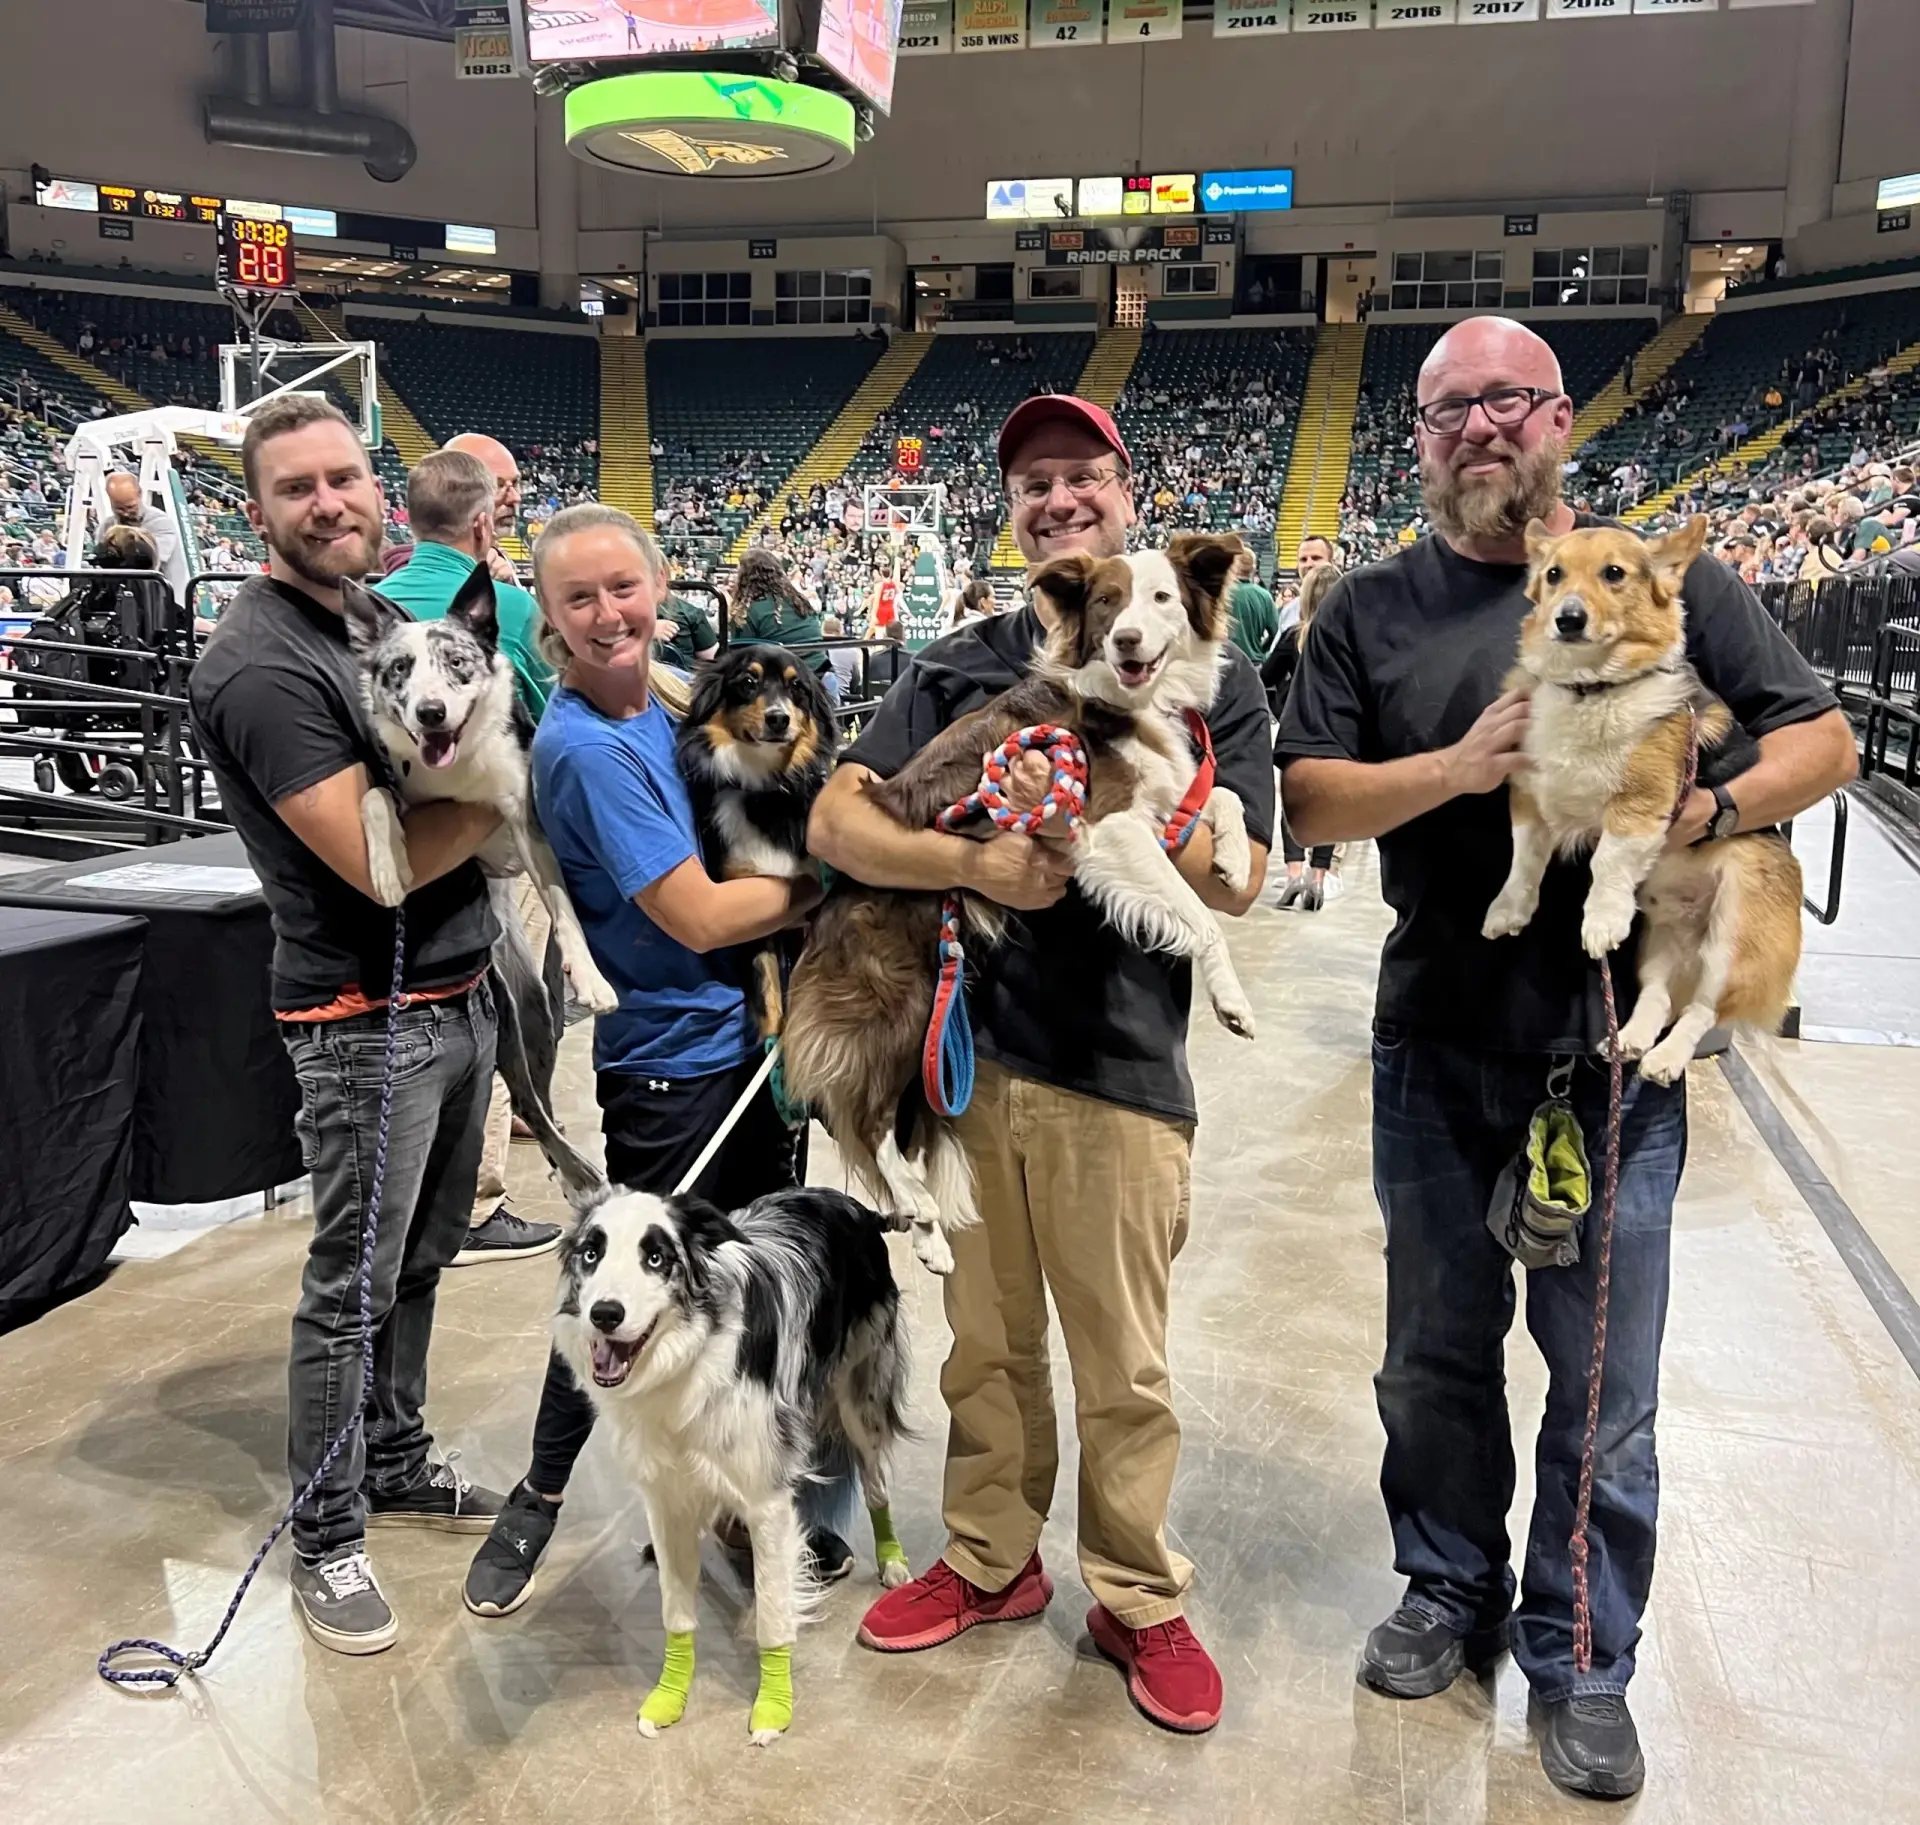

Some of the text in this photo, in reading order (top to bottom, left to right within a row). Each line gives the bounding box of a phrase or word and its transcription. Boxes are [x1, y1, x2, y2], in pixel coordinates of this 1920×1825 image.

[1391, 6, 1442, 20] 2016
[1473, 1, 1525, 15] 2017
[528, 11, 599, 31] STATE
[902, 13, 937, 22] ORIZON
[1227, 15, 1277, 29] 2014
[1307, 11, 1357, 25] 2015
[1056, 26, 1077, 40] 42
[1139, 22, 1151, 36] 4
[465, 34, 511, 58] NCAA
[898, 36, 939, 48] 2021
[987, 33, 1019, 46] WINS
[463, 64, 511, 76] 1983
[1224, 184, 1288, 195] Premier Health
[112, 198, 128, 211] 54
[147, 204, 176, 217] 17:32
[104, 227, 129, 237] 209
[231, 220, 288, 247] 17:32
[1508, 224, 1532, 233] 214
[1019, 239, 1041, 248] 212
[1208, 233, 1231, 242] 213
[753, 248, 773, 256] 211
[1066, 248, 1182, 264] RAIDER PACK
[239, 243, 284, 284] 20
[898, 449, 919, 466] 20
[882, 588, 895, 601] 23
